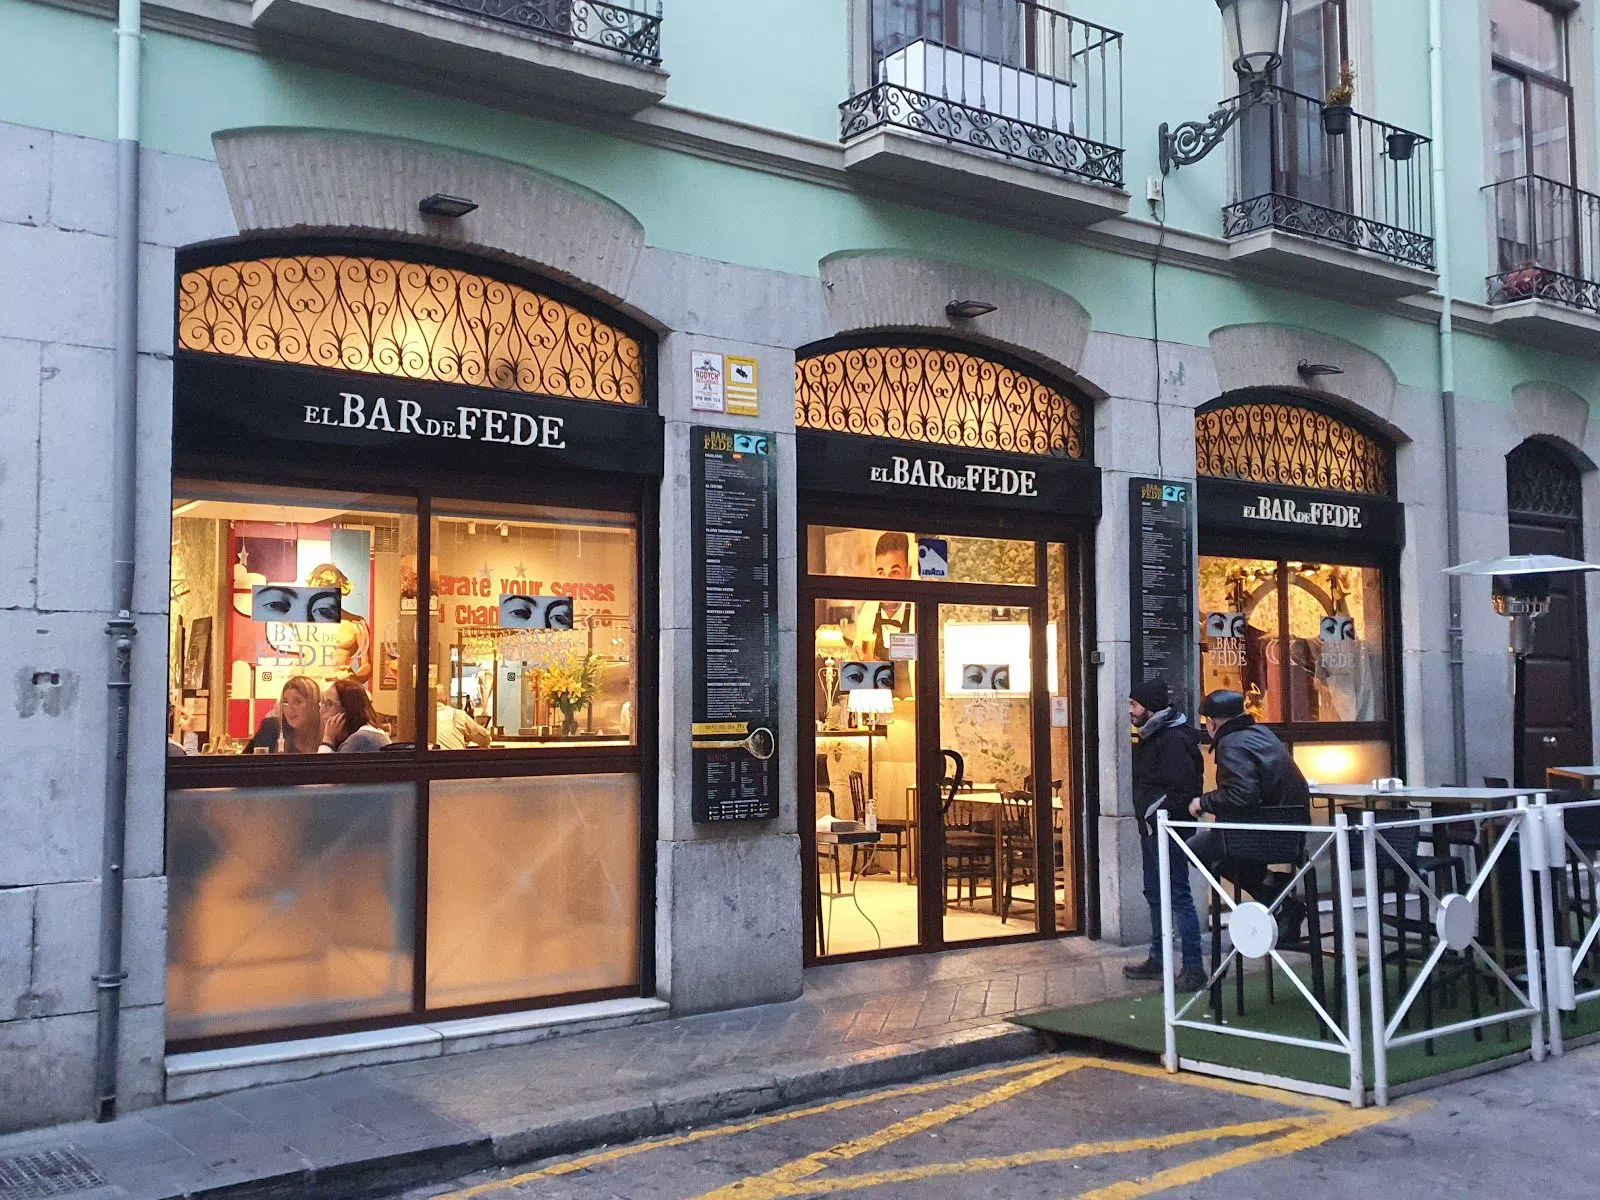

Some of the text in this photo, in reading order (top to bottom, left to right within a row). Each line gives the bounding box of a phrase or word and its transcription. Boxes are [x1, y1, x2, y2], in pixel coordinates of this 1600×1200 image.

[304, 392, 566, 449] EL BAR DE FEDE
[704, 439, 734, 451] FEDE
[711, 431, 726, 441] BAR
[869, 456, 1038, 497] EL BAR DE FEDE
[1243, 496, 1362, 529] EL BAR DE FEDE
[438, 575, 491, 597] erate
[274, 623, 319, 642] BAR
[1216, 636, 1239, 650] BAR
[1208, 650, 1248, 667] FEDE
